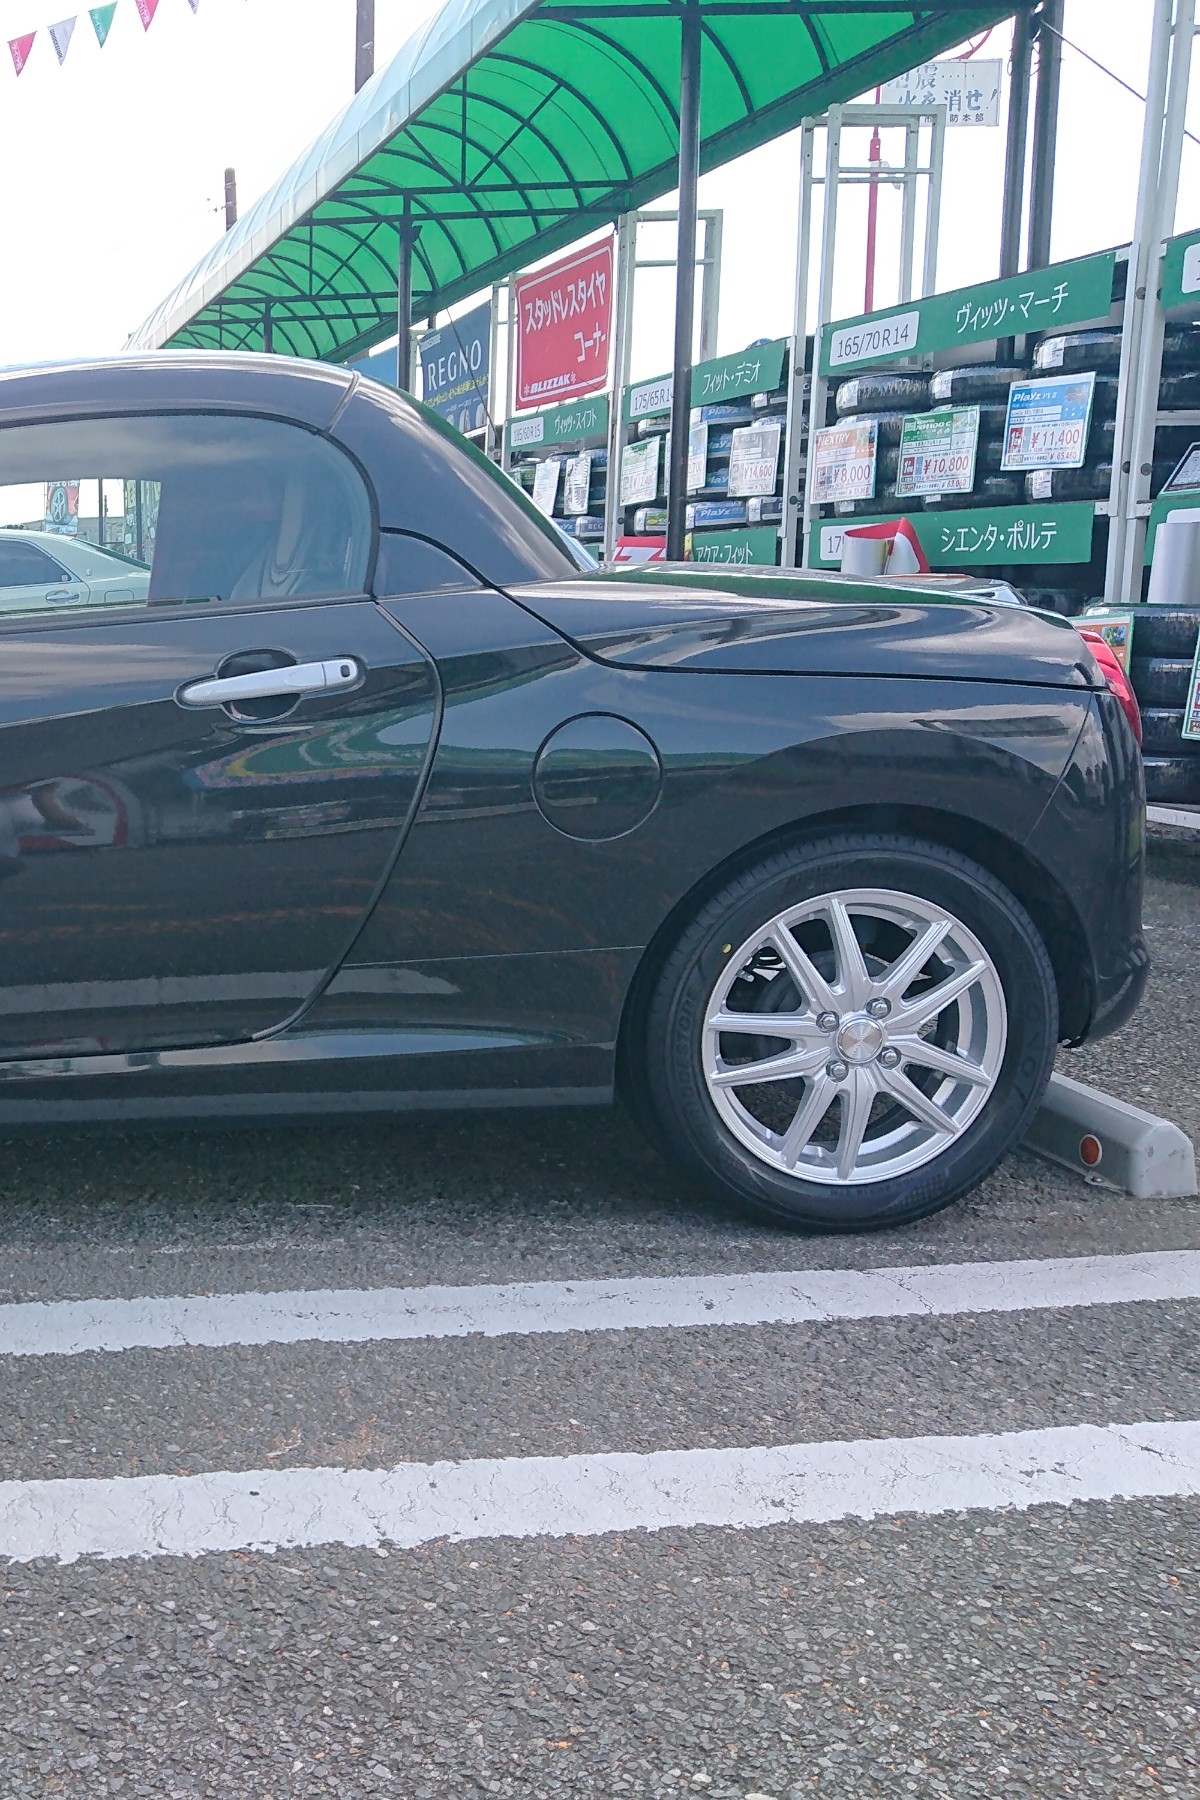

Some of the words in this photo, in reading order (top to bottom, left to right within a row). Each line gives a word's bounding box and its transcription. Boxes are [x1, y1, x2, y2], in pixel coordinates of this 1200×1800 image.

[525, 270, 606, 334] スタッドレスタイヤ
[956, 281, 1069, 334] ヴィッツ・マーチ
[574, 322, 606, 362] コーナー
[427, 339, 482, 392] REGNO
[702, 358, 761, 396] フィット・デミオ
[530, 372, 571, 394] BLIZZAK
[1013, 391, 1041, 402] Playz
[817, 432, 851, 447] NEXTRY
[1031, 428, 1080, 449] ¥11,400
[834, 464, 871, 484] ¥8,000
[923, 455, 969, 475] ¥10,800
[588, 522, 604, 530] REG
[941, 519, 1057, 553] シエンタ・ポルテ
[695, 541, 753, 565] アクア・フィット
